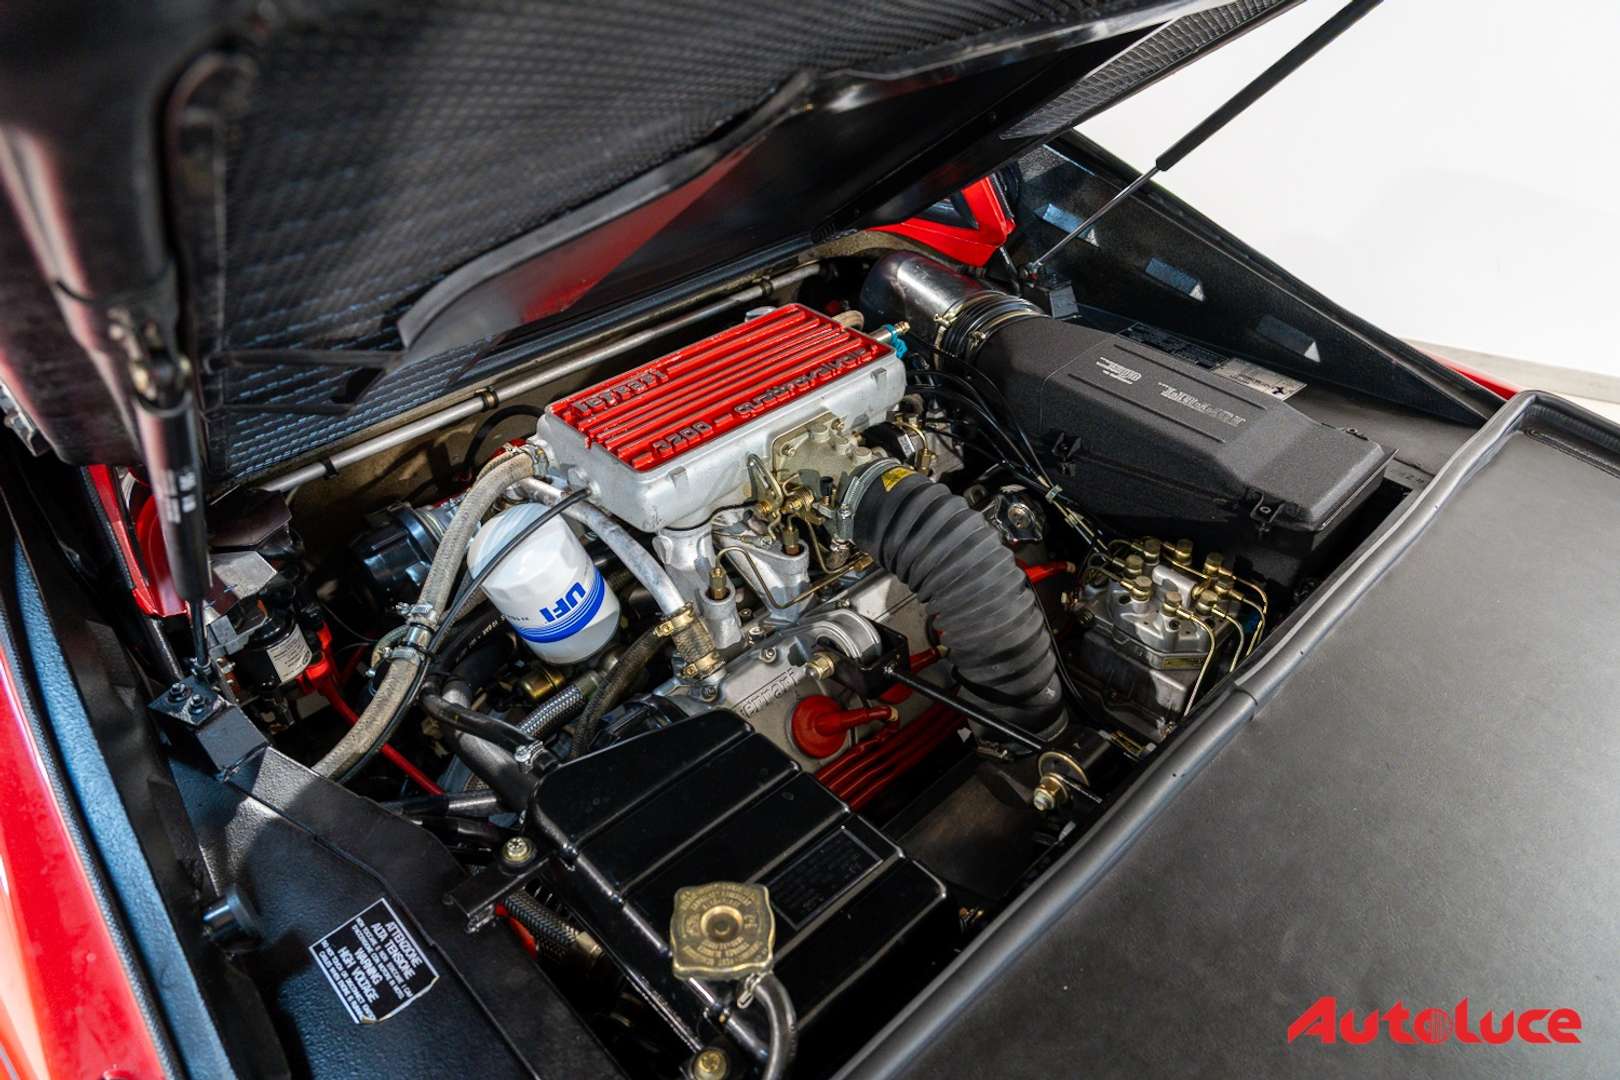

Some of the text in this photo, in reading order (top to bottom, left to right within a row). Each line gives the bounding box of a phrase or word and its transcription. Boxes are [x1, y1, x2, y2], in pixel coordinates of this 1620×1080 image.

[539, 582, 586, 622] UFI
[353, 946, 383, 985] WARNING
[370, 922, 415, 980] ALTA TENSIONE
[384, 921, 422, 968] ATTENZIONE
[337, 947, 379, 1003] HIGH VOLTAGE
